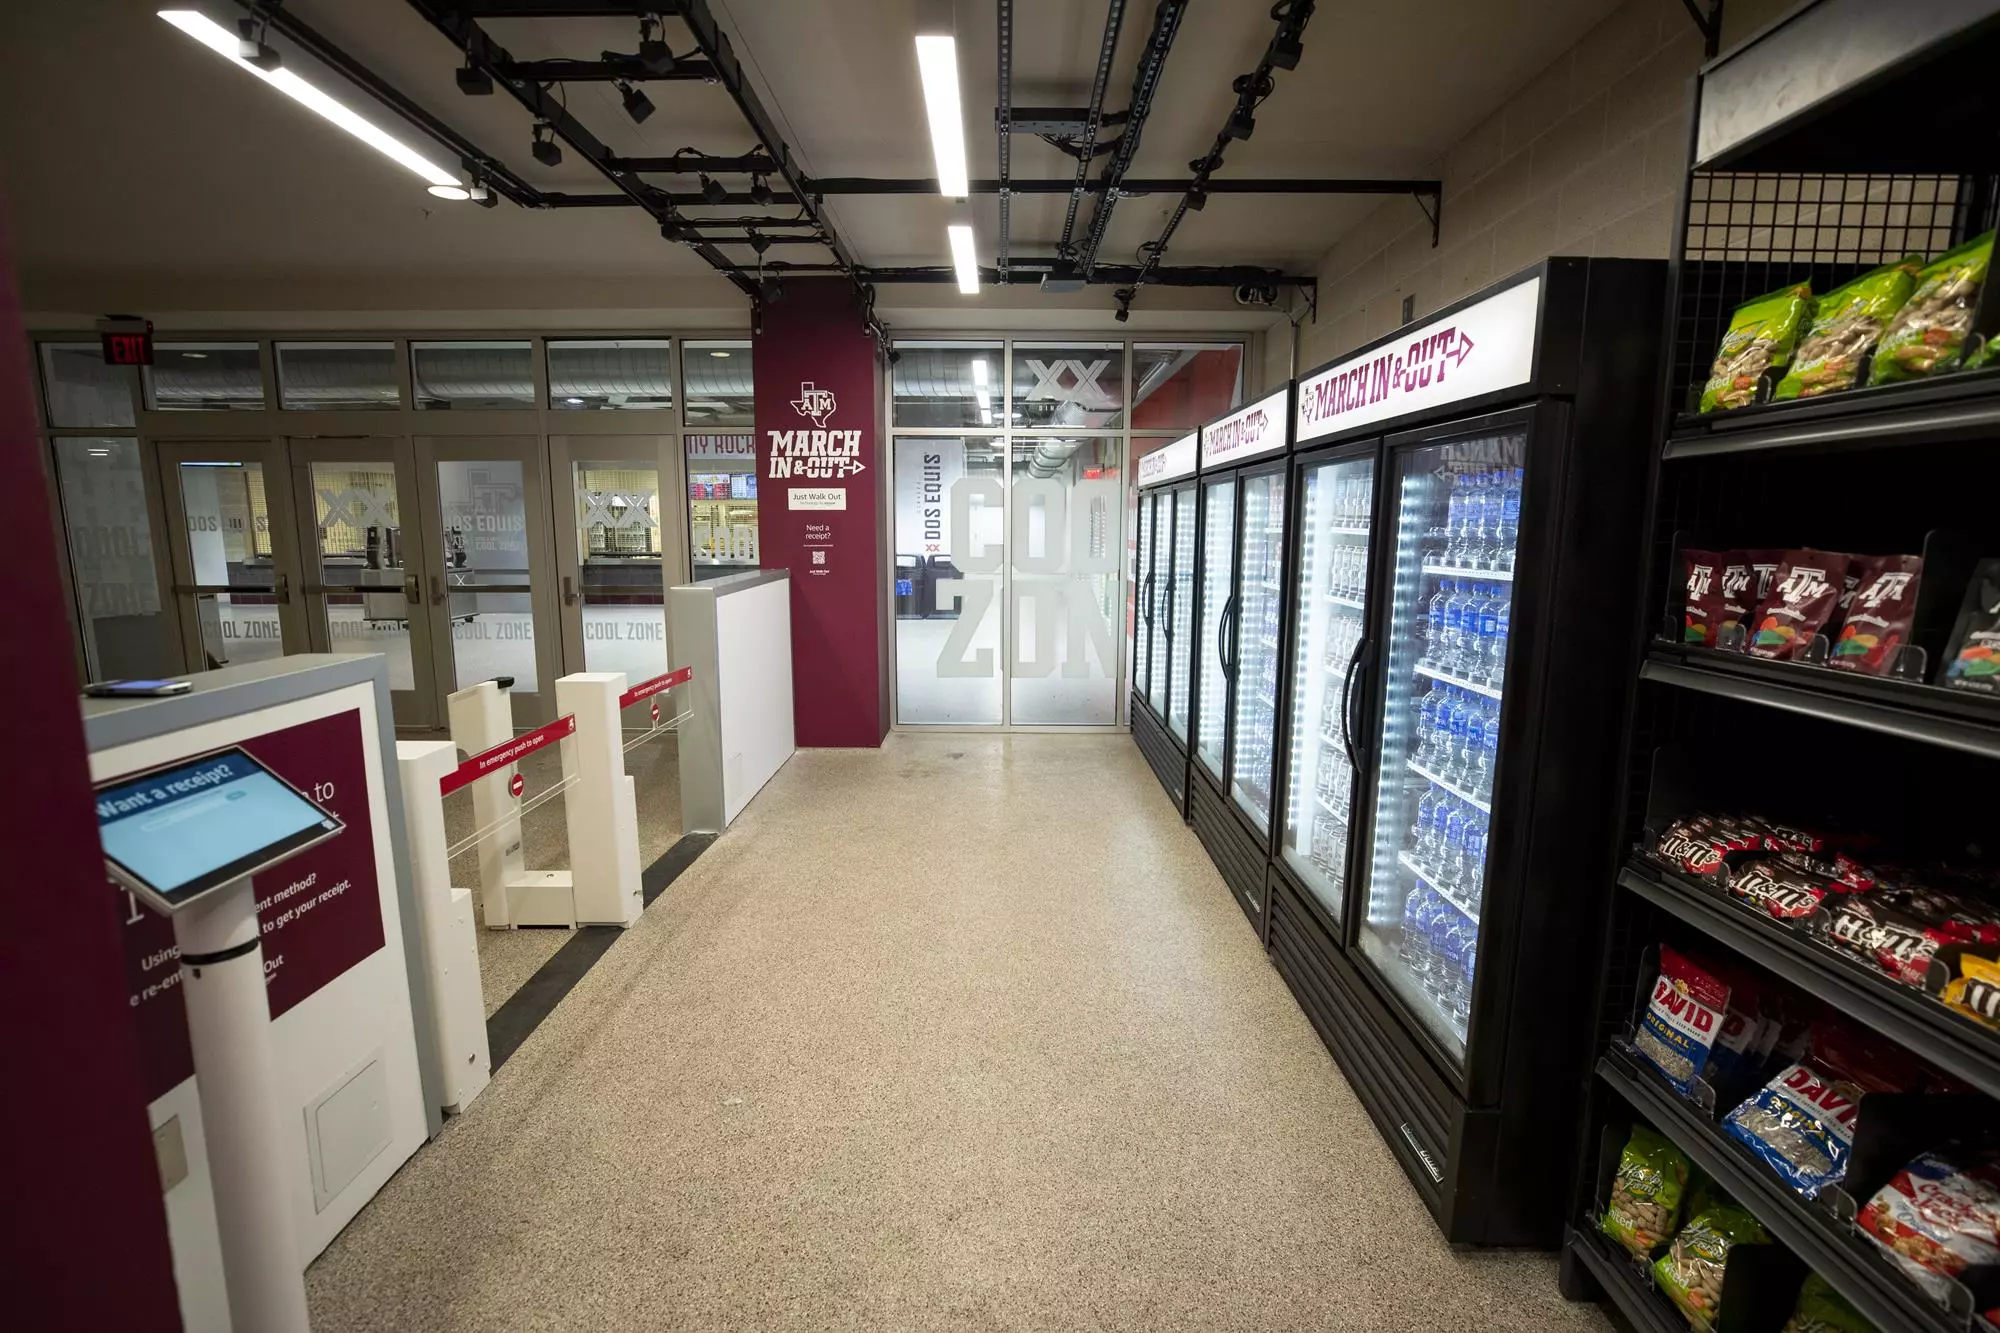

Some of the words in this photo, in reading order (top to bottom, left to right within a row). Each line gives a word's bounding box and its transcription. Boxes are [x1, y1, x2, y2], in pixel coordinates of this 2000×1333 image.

[111, 336, 144, 364] EXIT
[1315, 362, 1369, 421] MARCH
[767, 430, 862, 457] MARCH
[1209, 420, 1233, 456] MARCH
[924, 454, 942, 503] EQUIS
[808, 492, 826, 500] Walk
[476, 514, 523, 532] EQUIS
[805, 532, 831, 540] receipt?
[925, 508, 941, 540] DOS
[244, 621, 281, 639] ZONE
[454, 621, 492, 640] COOL
[495, 621, 532, 640] ZONE
[585, 622, 623, 640] COOL
[627, 622, 664, 640] ZONE
[480, 760, 486, 770] In
[486, 747, 515, 763] emergency
[514, 741, 527, 755] push
[526, 739, 533, 747] to
[532, 734, 545, 745] open
[95, 791, 154, 818] Want
[150, 787, 169, 800] a
[165, 763, 234, 794] receipt?
[313, 781, 335, 803] to
[274, 872, 317, 904] method?
[262, 920, 274, 934] to
[276, 909, 294, 929] get
[294, 897, 317, 920] your
[318, 878, 352, 904] receipt.
[263, 954, 285, 974] Out
[1646, 1012, 1689, 1048] ORIGINAL
